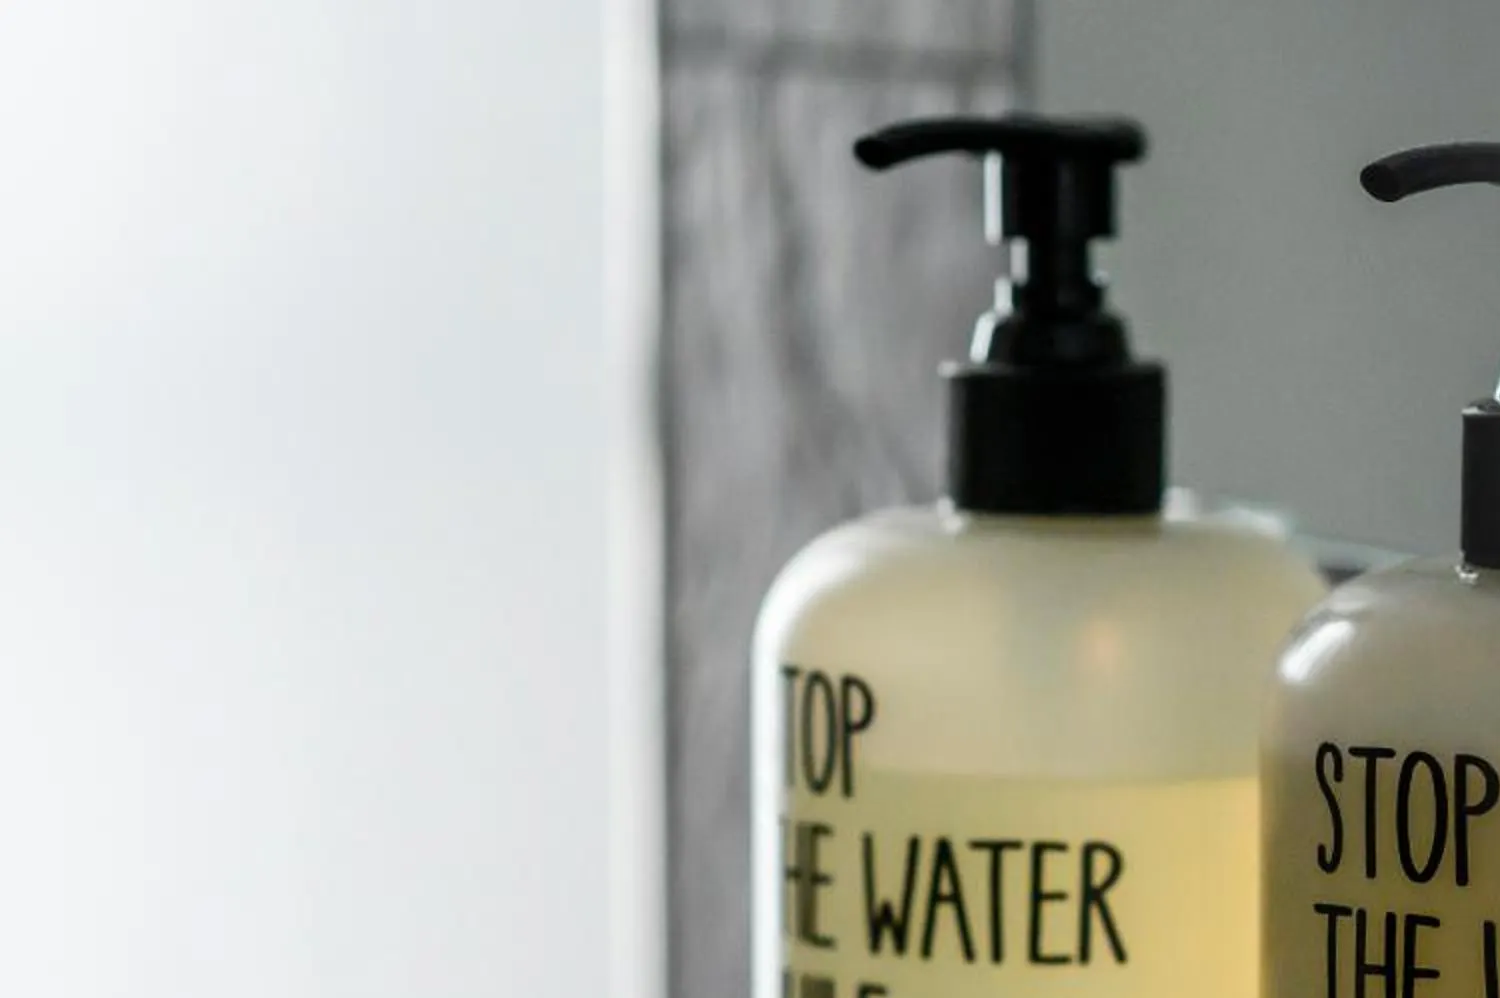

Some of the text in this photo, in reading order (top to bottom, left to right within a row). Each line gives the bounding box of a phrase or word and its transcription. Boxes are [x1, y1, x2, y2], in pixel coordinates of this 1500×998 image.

[781, 665, 875, 798] TOP
[1315, 741, 1500, 887] STOP
[781, 819, 1127, 965] HE WATER
